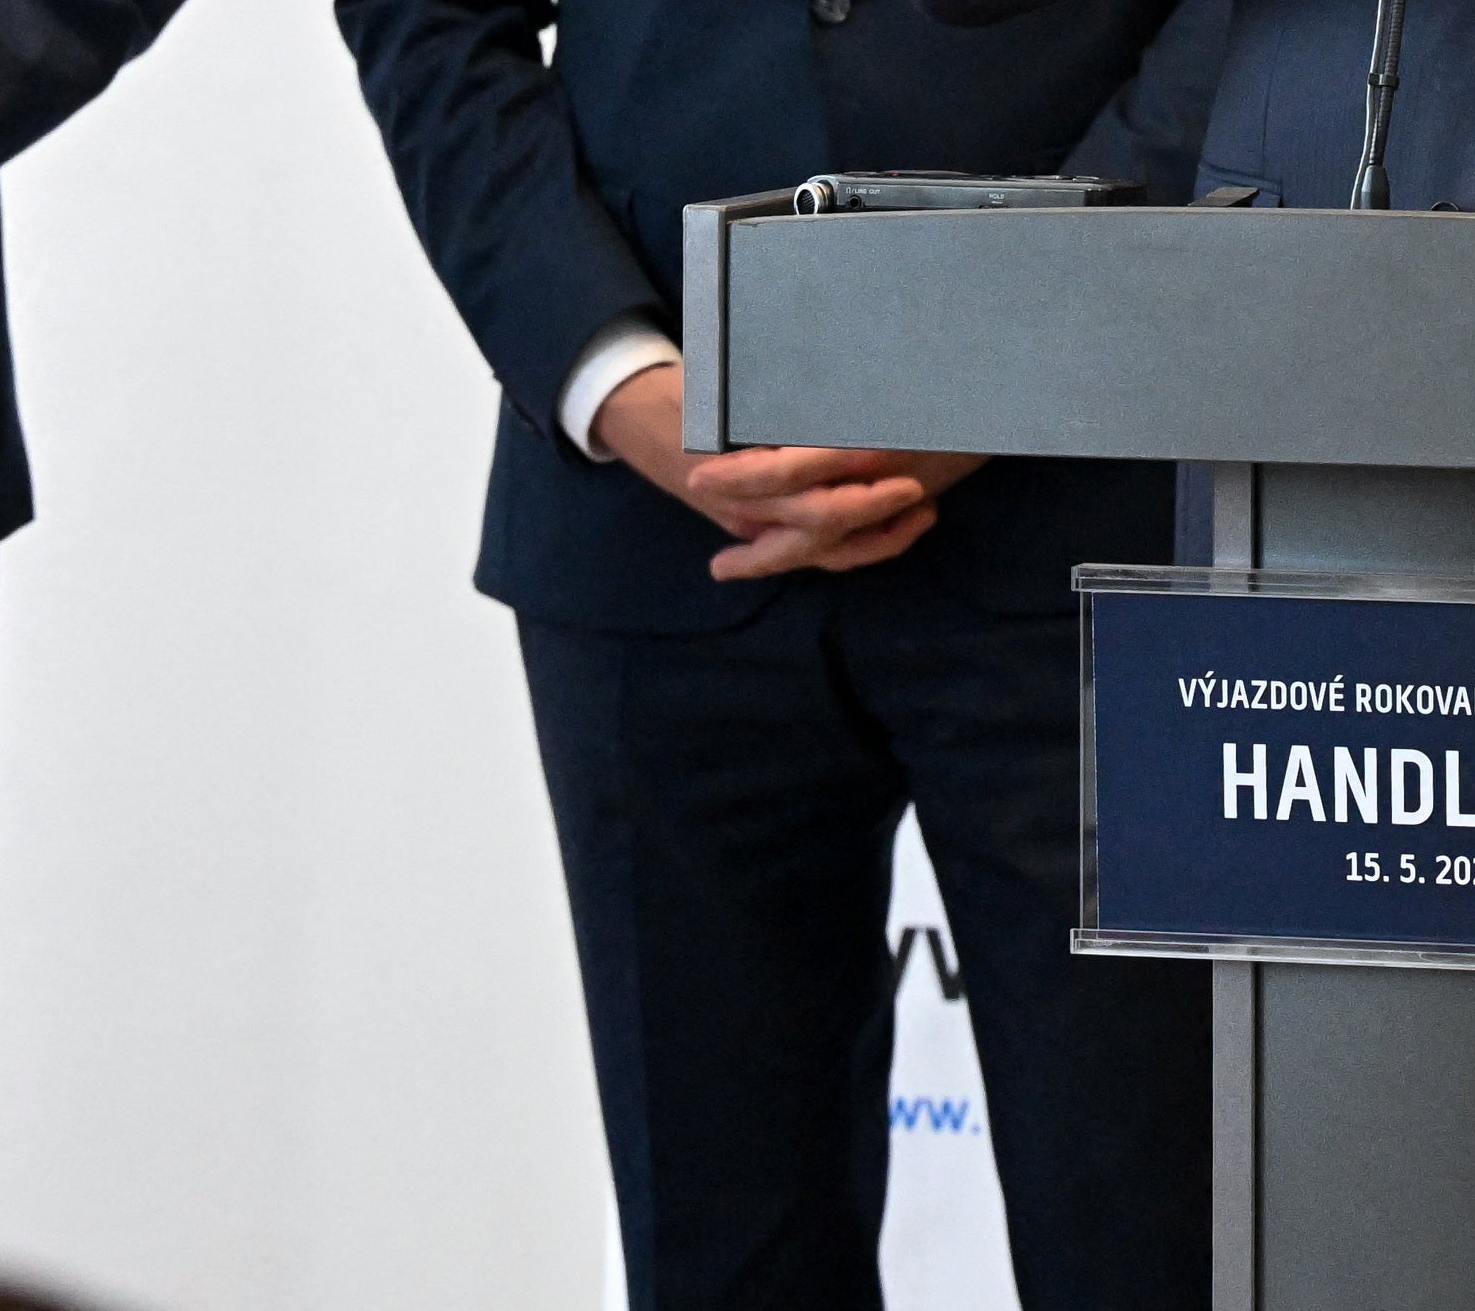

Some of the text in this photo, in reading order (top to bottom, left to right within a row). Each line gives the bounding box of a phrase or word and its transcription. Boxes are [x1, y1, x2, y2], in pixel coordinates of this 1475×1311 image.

[1178, 670, 1345, 712] VÝJAZDOVÉ
[1345, 851, 1390, 883] 15.
[1399, 853, 1426, 884] 5.
